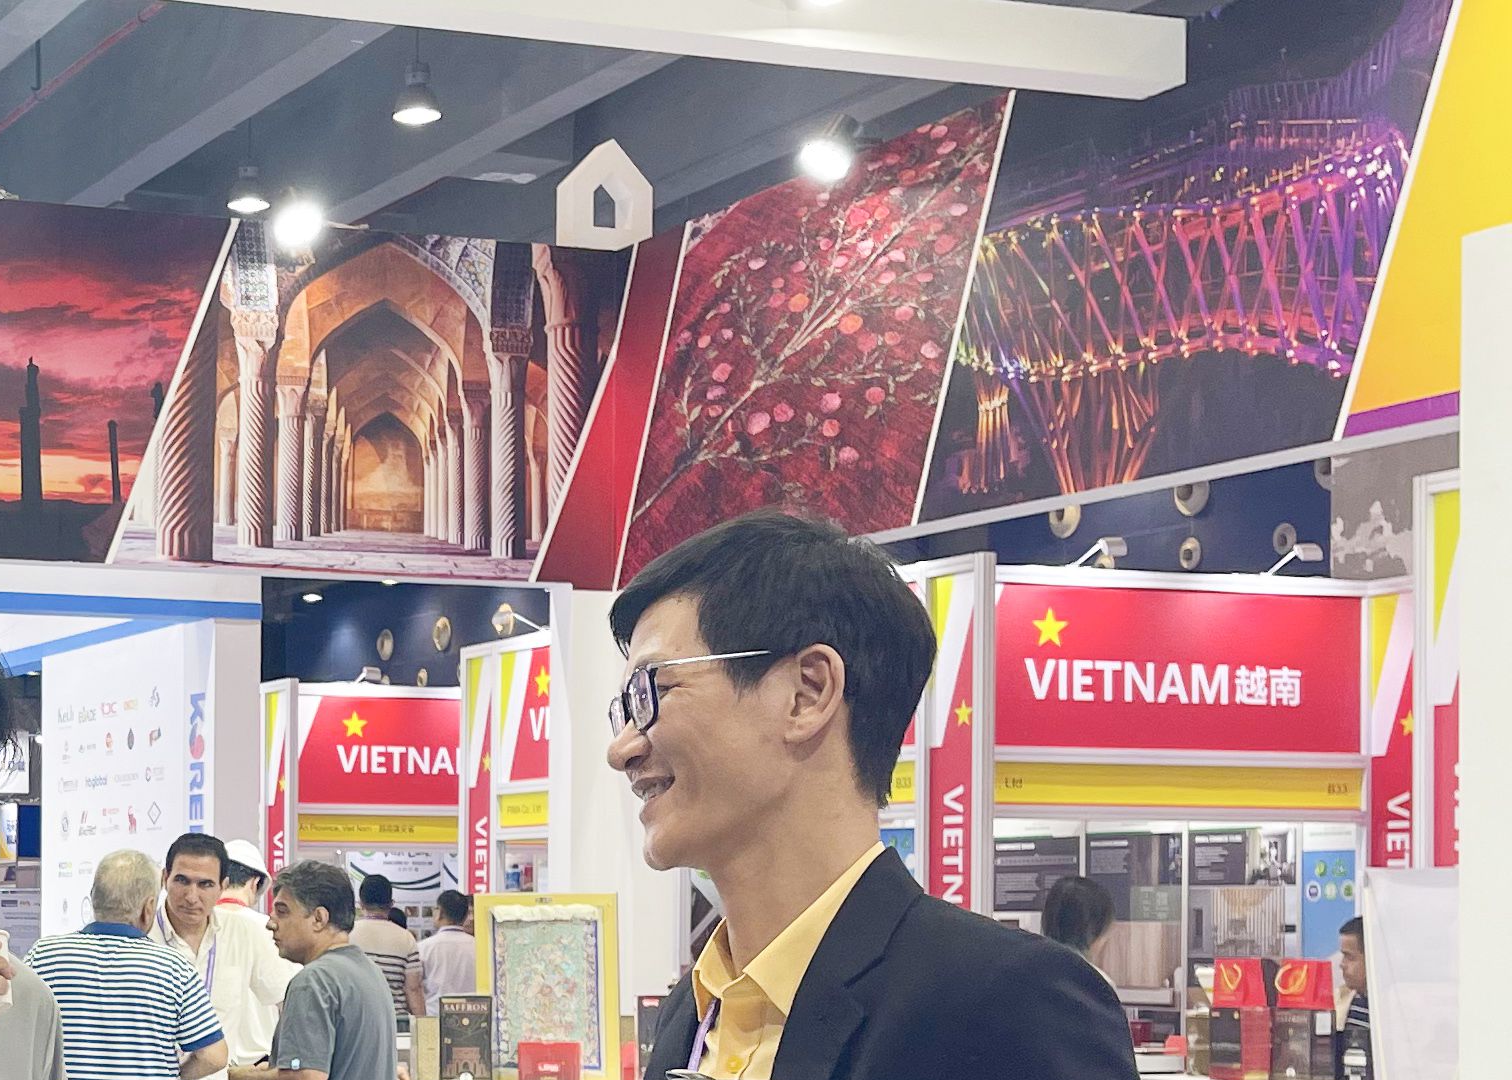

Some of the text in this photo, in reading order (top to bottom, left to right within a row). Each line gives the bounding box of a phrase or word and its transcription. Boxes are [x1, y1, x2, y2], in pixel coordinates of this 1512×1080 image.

[1024, 657, 1303, 708] VIETNAM 越南
[336, 744, 460, 776] VIETNA
[443, 1002, 488, 1012] SAFFRON
